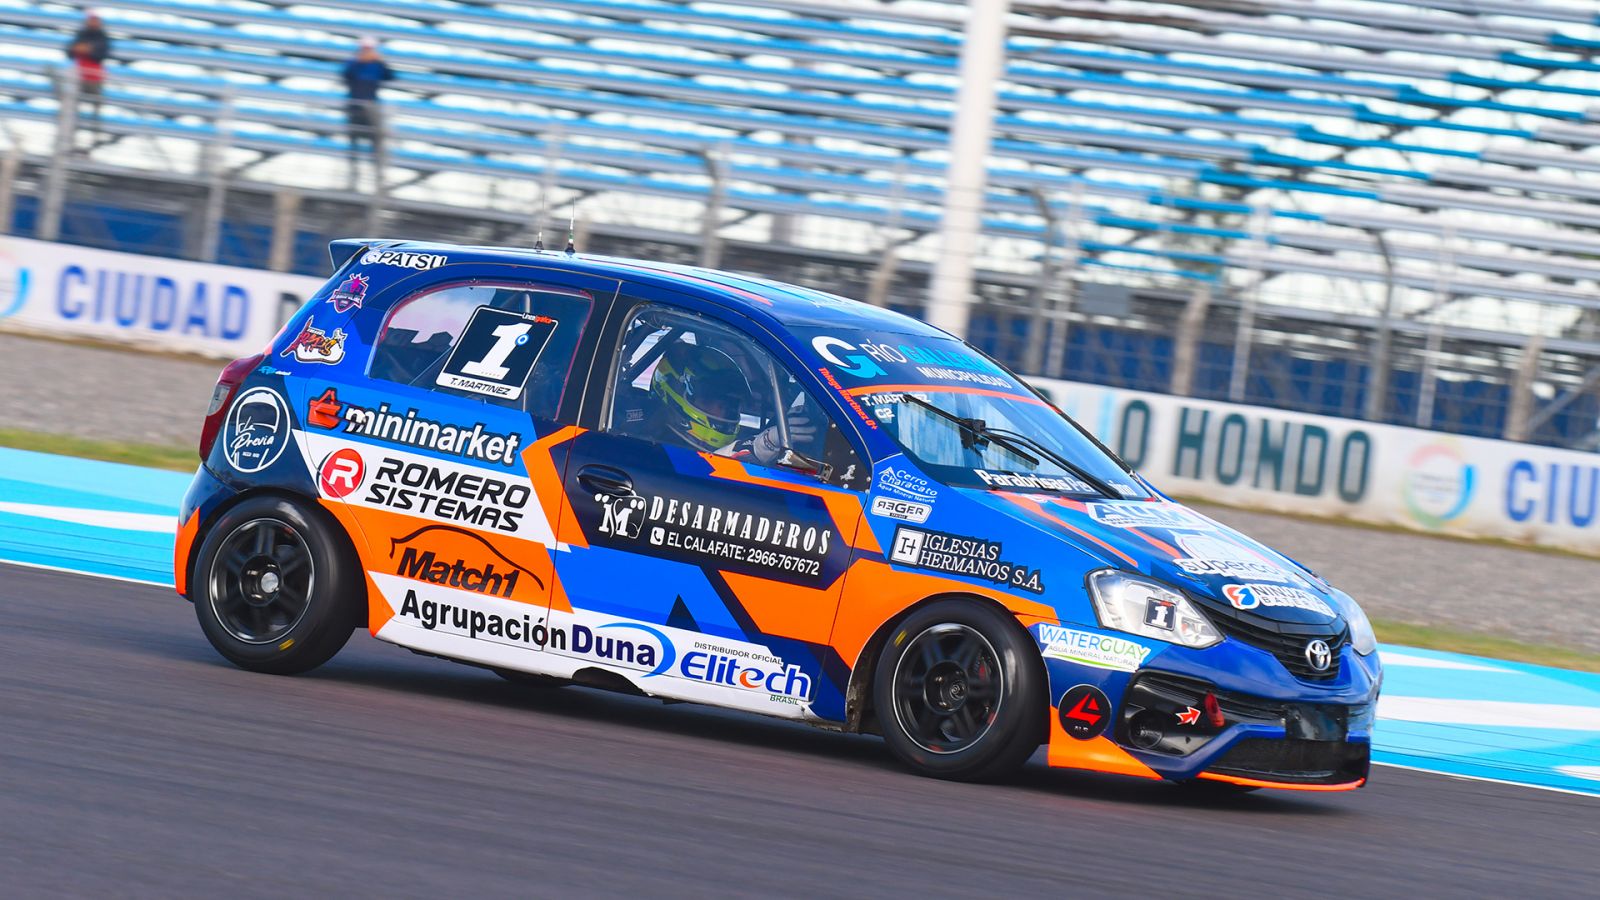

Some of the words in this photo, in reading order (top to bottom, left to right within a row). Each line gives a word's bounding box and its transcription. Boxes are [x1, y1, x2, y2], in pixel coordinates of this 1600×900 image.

[57, 264, 250, 341] CIUDAD
[458, 379, 511, 396] MARTINEZ
[916, 366, 1013, 389] MUNICIPALIDAD
[345, 404, 519, 465] minimarket
[1172, 403, 1374, 503] HONDO
[375, 457, 531, 509] ROMERO
[880, 474, 938, 496] Characato
[896, 469, 928, 486] Cerro
[973, 469, 1071, 491] Parabrisas
[365, 483, 524, 532] SISTEMAS
[648, 495, 832, 555] DESARMADEROS
[666, 531, 681, 547] EL
[684, 534, 746, 561] CALAFATE:
[747, 547, 820, 576] 2966-767672
[921, 533, 999, 561] IGLESIAS
[396, 547, 521, 598] Match1
[918, 549, 1010, 581] HERMANOS
[1012, 569, 1043, 591] S.A.
[400, 588, 567, 651] Agrupación
[571, 623, 656, 667] Duna
[1040, 625, 1150, 661] WATERGUAY
[680, 650, 810, 698] Elitech
[694, 641, 750, 659] DISTRIBUIDOR
[751, 653, 783, 666] OFICIAL
[1048, 645, 1069, 654] AGUA
[1069, 648, 1101, 659] MINERAL
[1103, 654, 1138, 668] NATURAL
[769, 694, 799, 706] BRASIL
